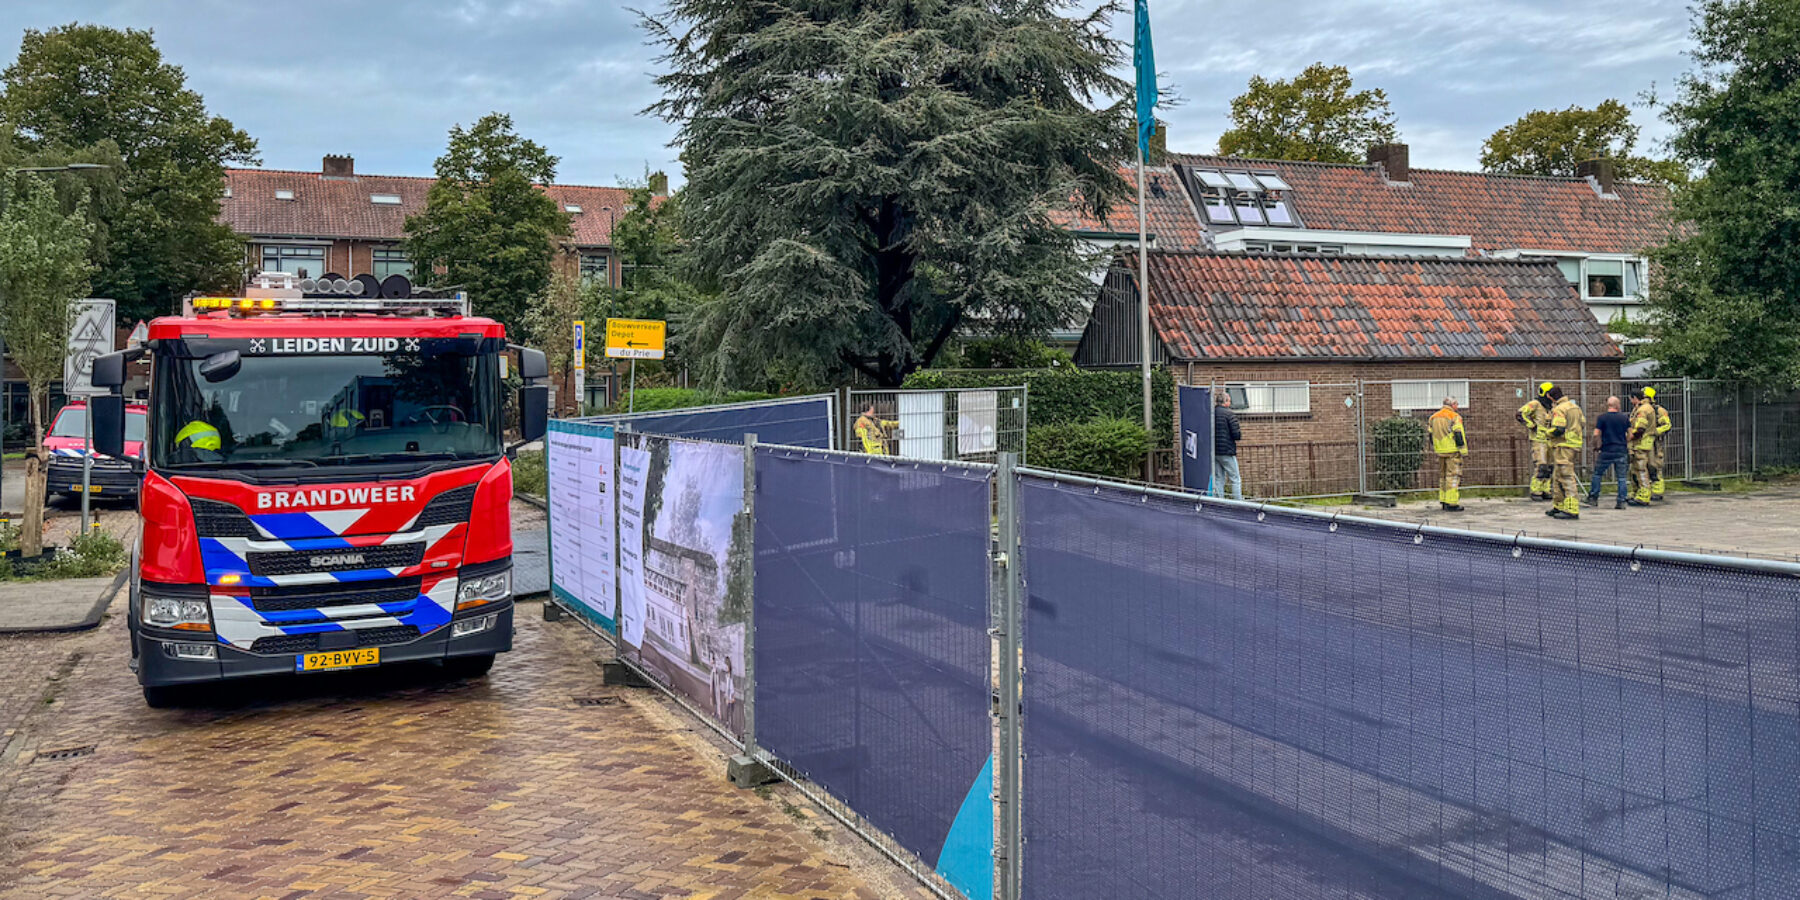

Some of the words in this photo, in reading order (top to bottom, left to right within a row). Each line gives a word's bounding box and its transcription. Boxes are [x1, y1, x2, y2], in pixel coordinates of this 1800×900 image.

[612, 322, 661, 330] Bouwverkeer
[272, 338, 345, 353] LEIDEN
[351, 338, 399, 352] ZUID
[620, 349, 631, 357] du
[257, 486, 415, 509] BRANDWEER
[310, 554, 364, 567] SCANIA
[309, 650, 375, 667] 92-BVV-5
